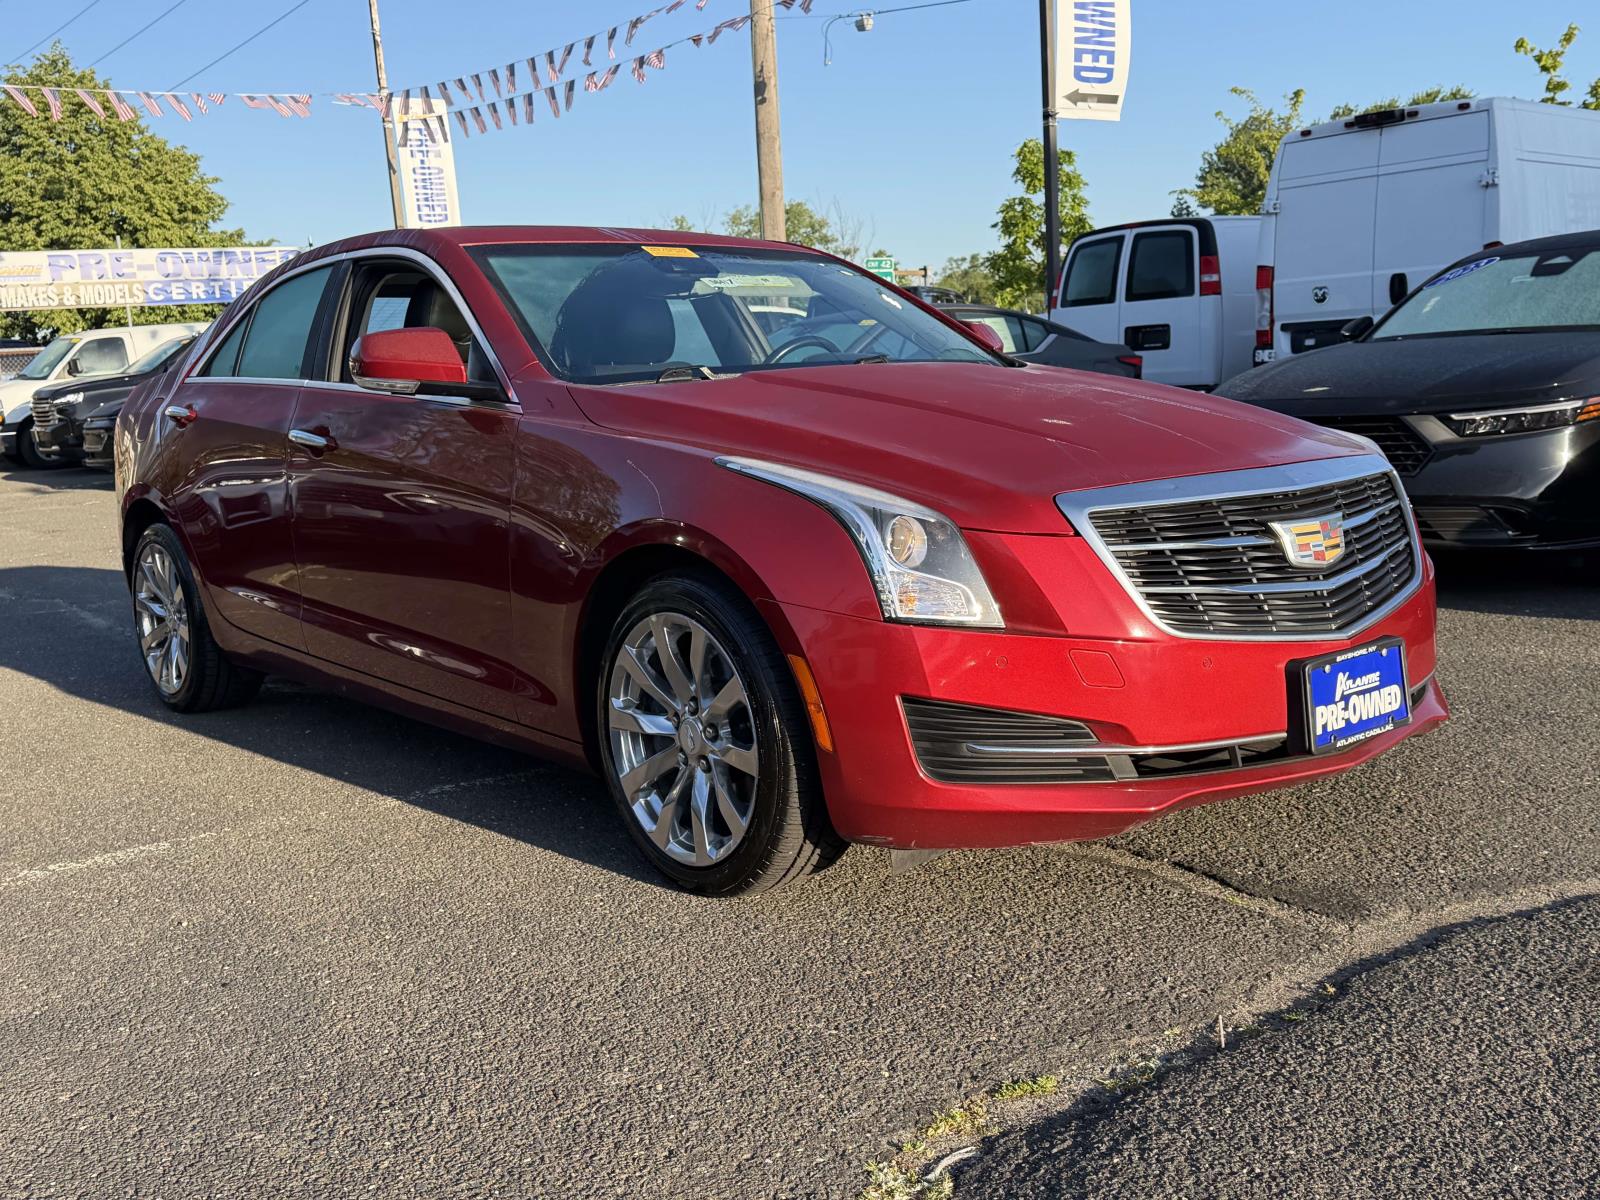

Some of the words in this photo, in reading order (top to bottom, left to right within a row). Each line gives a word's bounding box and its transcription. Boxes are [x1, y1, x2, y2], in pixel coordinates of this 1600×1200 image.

[0, 284, 59, 308] MAKES
[63, 285, 78, 306] &
[80, 282, 144, 305] MODELS
[1315, 684, 1401, 735] PRE-OWNED
[1336, 734, 1365, 748] ATLANTIC
[1365, 723, 1394, 738] CADILLAC
